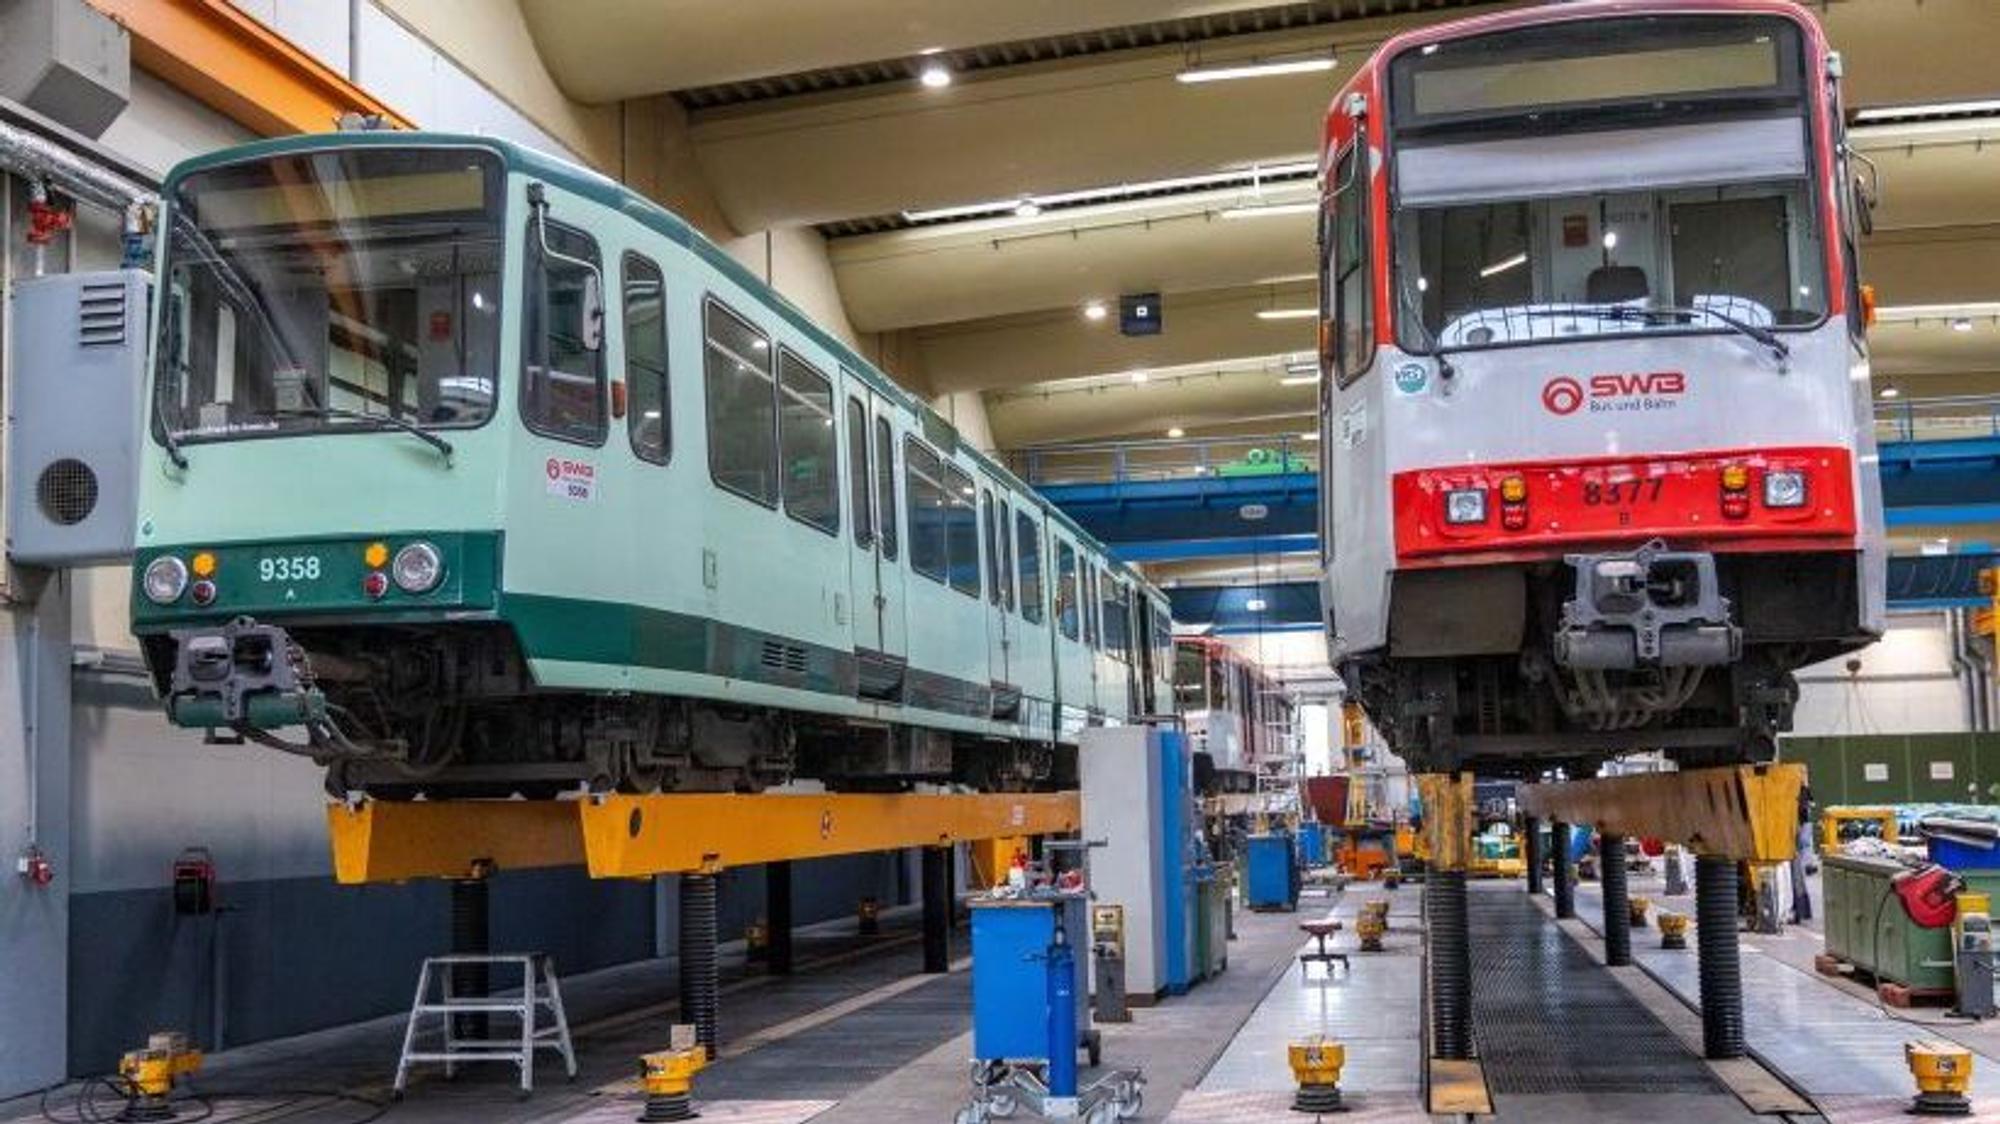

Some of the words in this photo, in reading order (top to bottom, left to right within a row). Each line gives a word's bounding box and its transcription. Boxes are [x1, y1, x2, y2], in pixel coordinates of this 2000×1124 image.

[1590, 373, 1685, 396] SWB
[1590, 400, 1613, 412] Bus
[1614, 400, 1640, 411] und
[1644, 398, 1676, 410] Bahn
[1583, 477, 1664, 506] 8377
[260, 555, 321, 581] 9358
[285, 588, 297, 601] A
